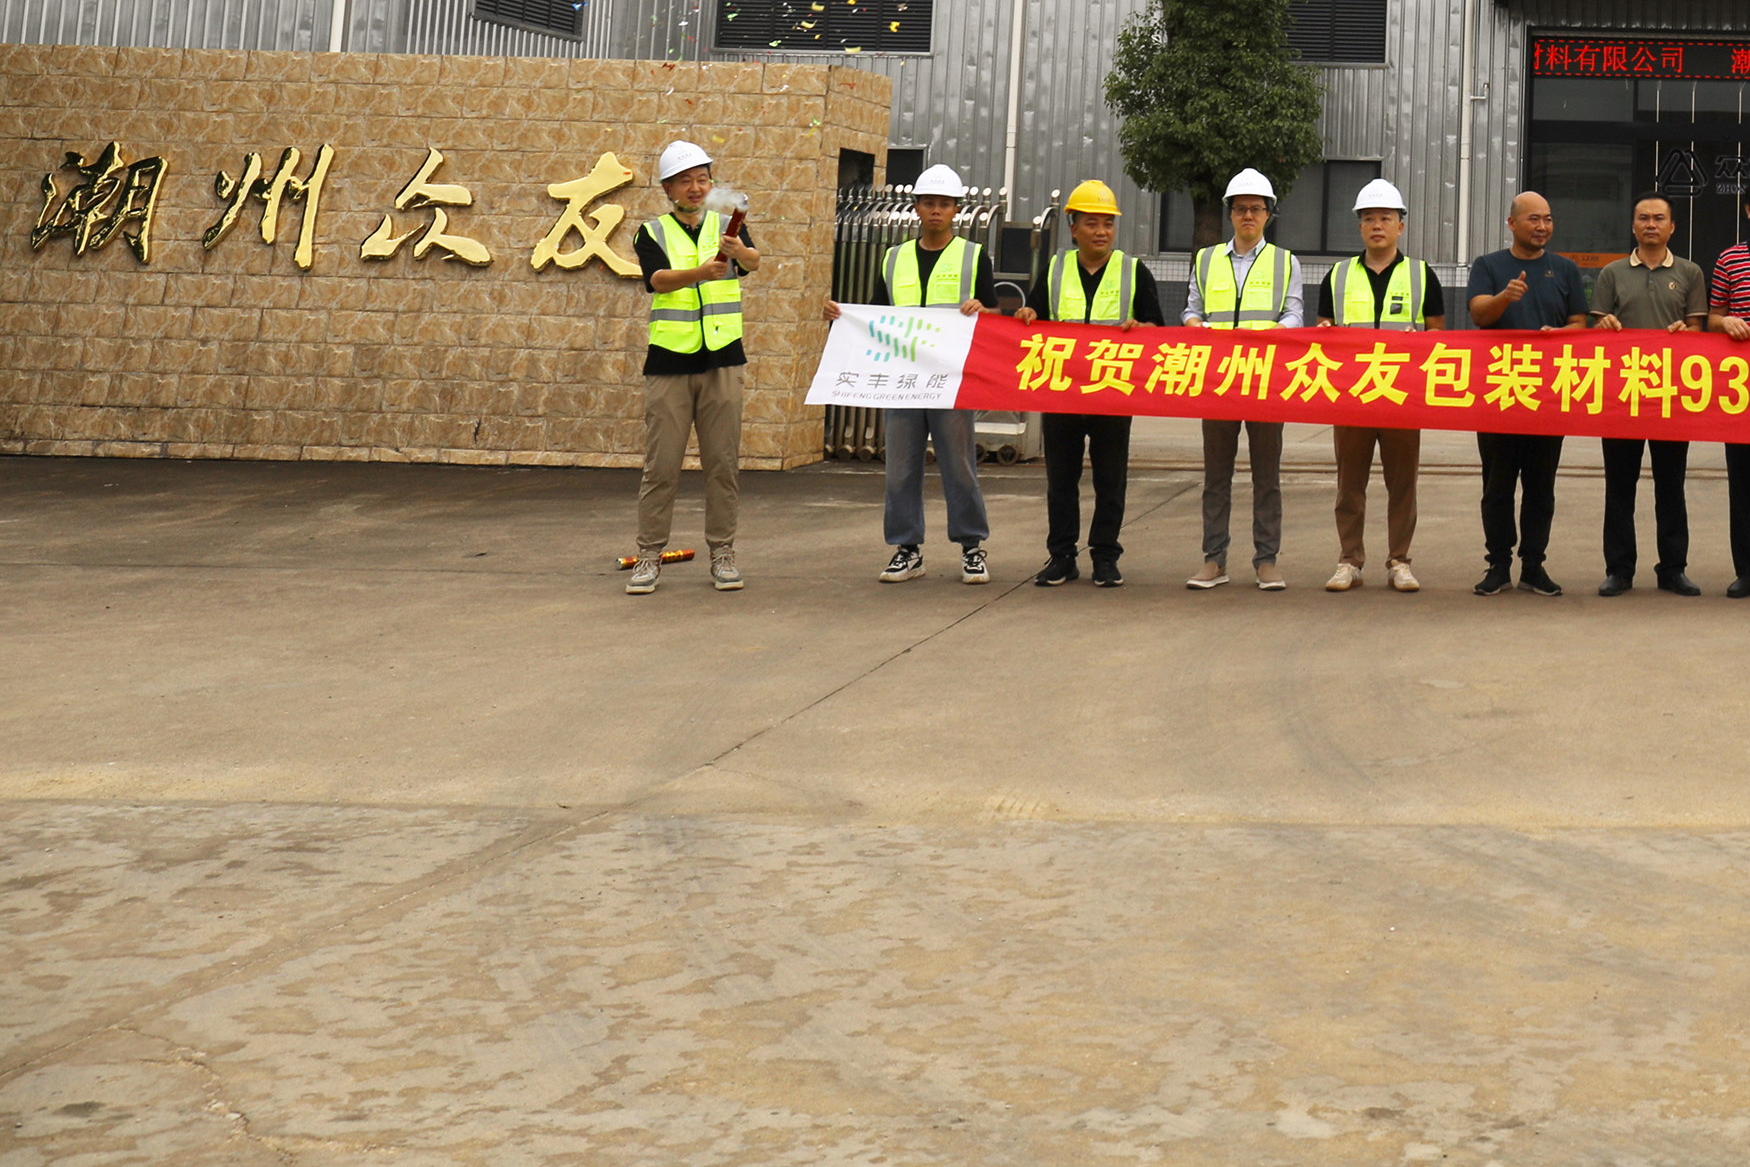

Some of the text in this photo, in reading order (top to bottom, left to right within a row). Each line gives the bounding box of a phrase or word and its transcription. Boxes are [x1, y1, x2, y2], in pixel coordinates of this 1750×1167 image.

[31, 141, 643, 280] 潮州众友
[835, 371, 949, 389] 实丰绿能
